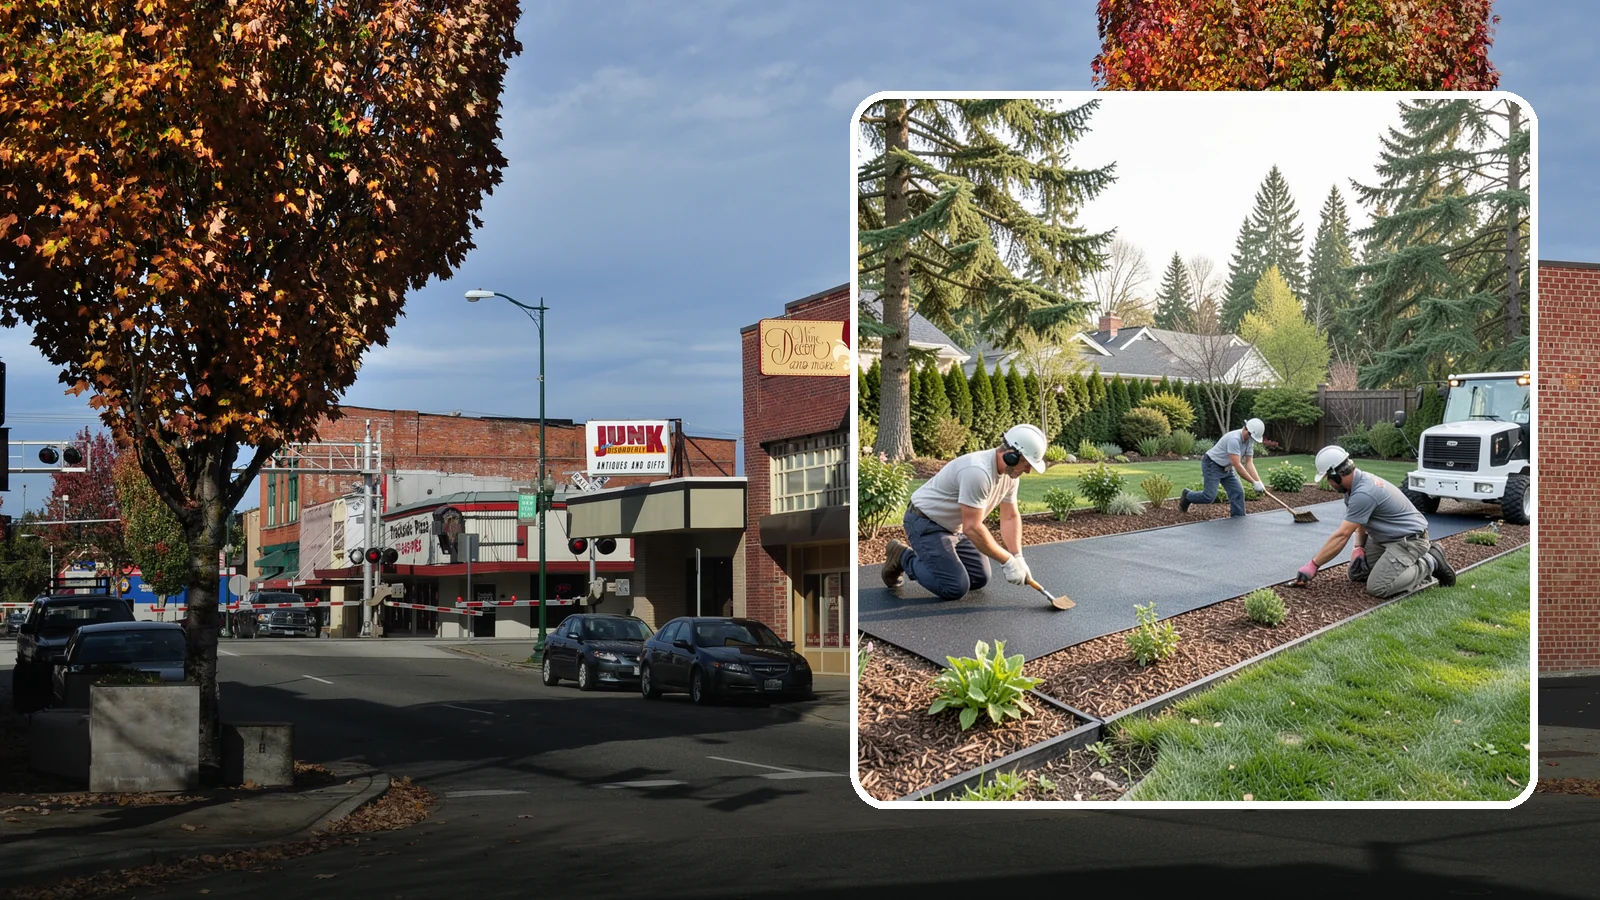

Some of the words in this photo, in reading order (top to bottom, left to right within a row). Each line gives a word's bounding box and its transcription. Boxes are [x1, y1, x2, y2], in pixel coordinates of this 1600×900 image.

[765, 328, 831, 365] Decor
[595, 425, 665, 457] JUNK
[607, 446, 646, 454] DISORDERLY
[597, 461, 628, 470] ANTIQUES
[631, 461, 644, 470] AND
[647, 460, 665, 469] GIFTS
[390, 521, 413, 540] Trackside
[414, 519, 429, 535] Pizza
